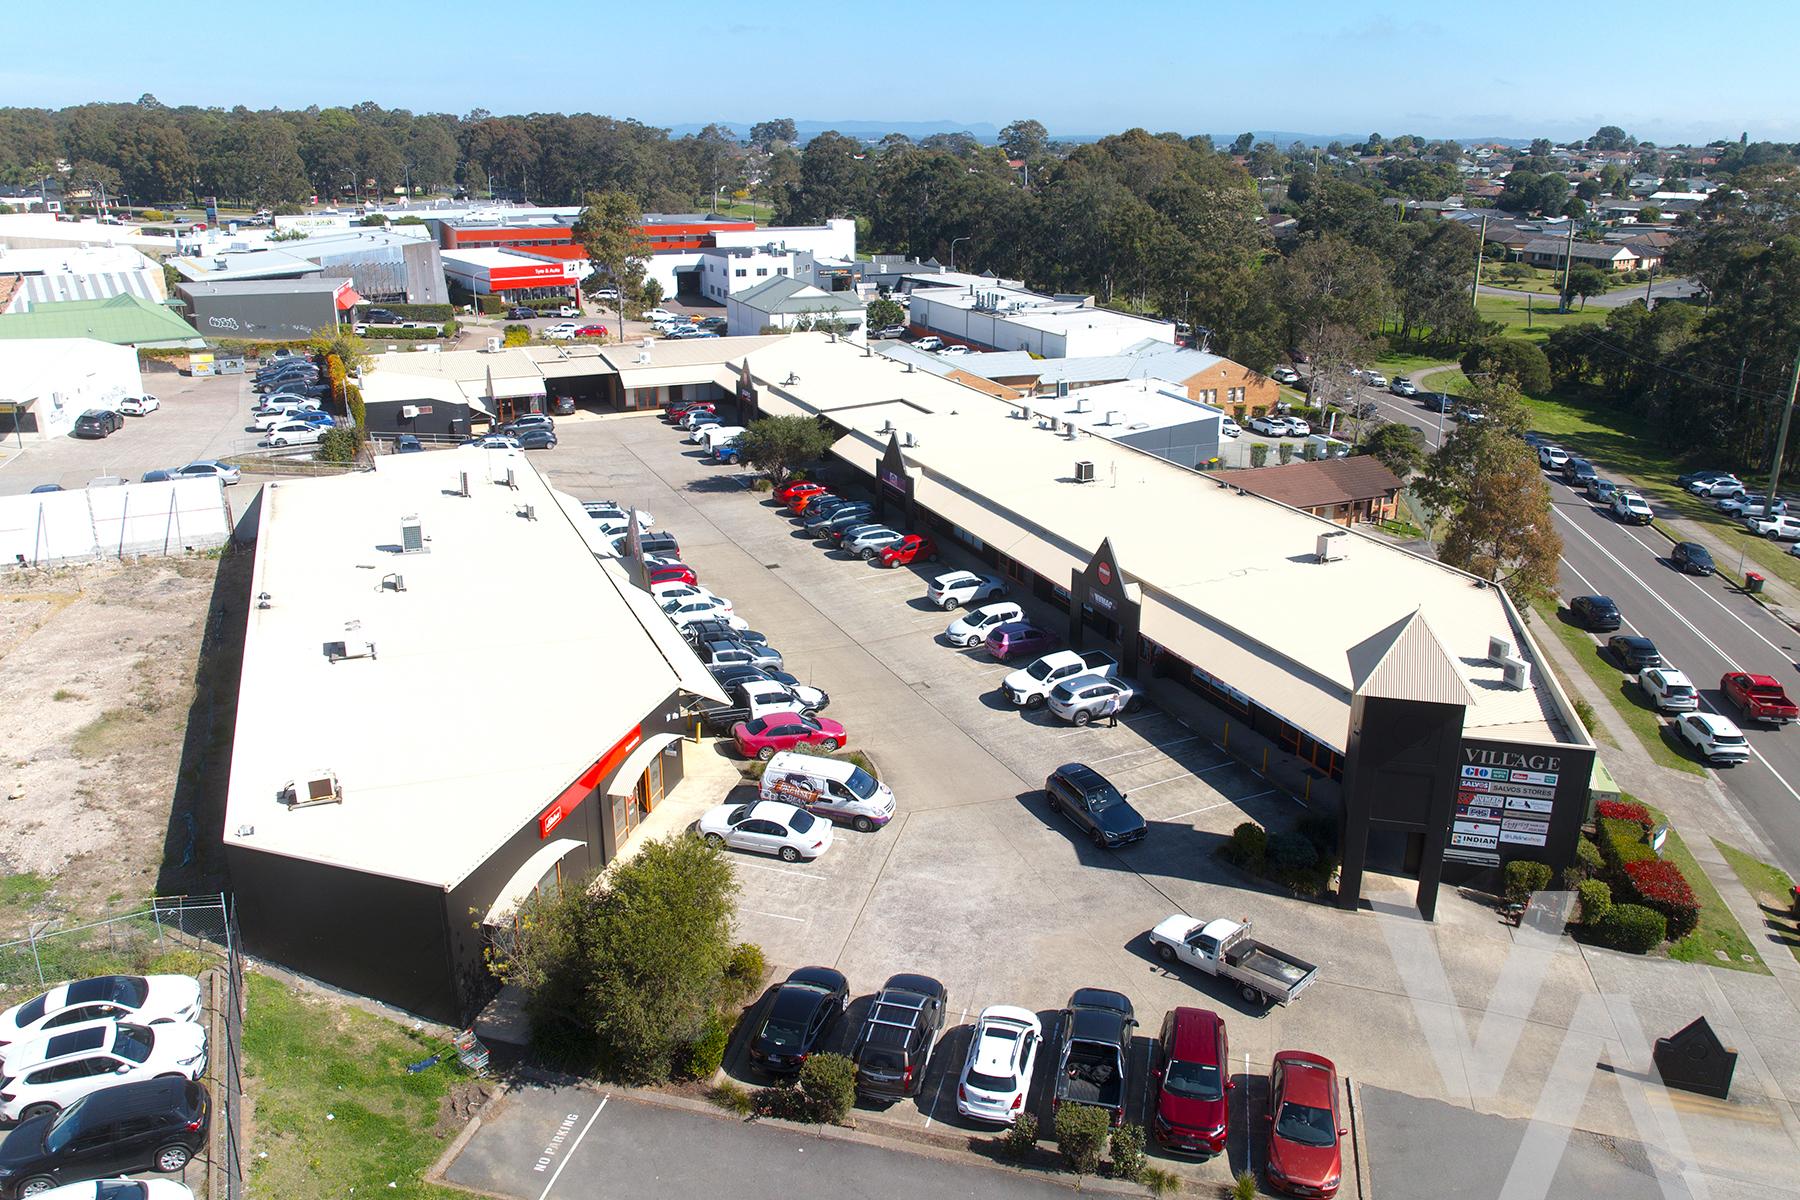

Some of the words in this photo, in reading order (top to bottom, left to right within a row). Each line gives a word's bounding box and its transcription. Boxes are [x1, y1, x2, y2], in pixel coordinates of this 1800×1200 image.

[1464, 747, 1561, 772] VILLAGE
[1461, 780, 1489, 789] SALVOS
[1493, 785, 1521, 793] SALVOS
[1523, 788, 1552, 797] STORES
[1463, 835, 1496, 845] INDIAN
[533, 1156, 551, 1172] NO
[543, 1113, 579, 1155] PARKING
